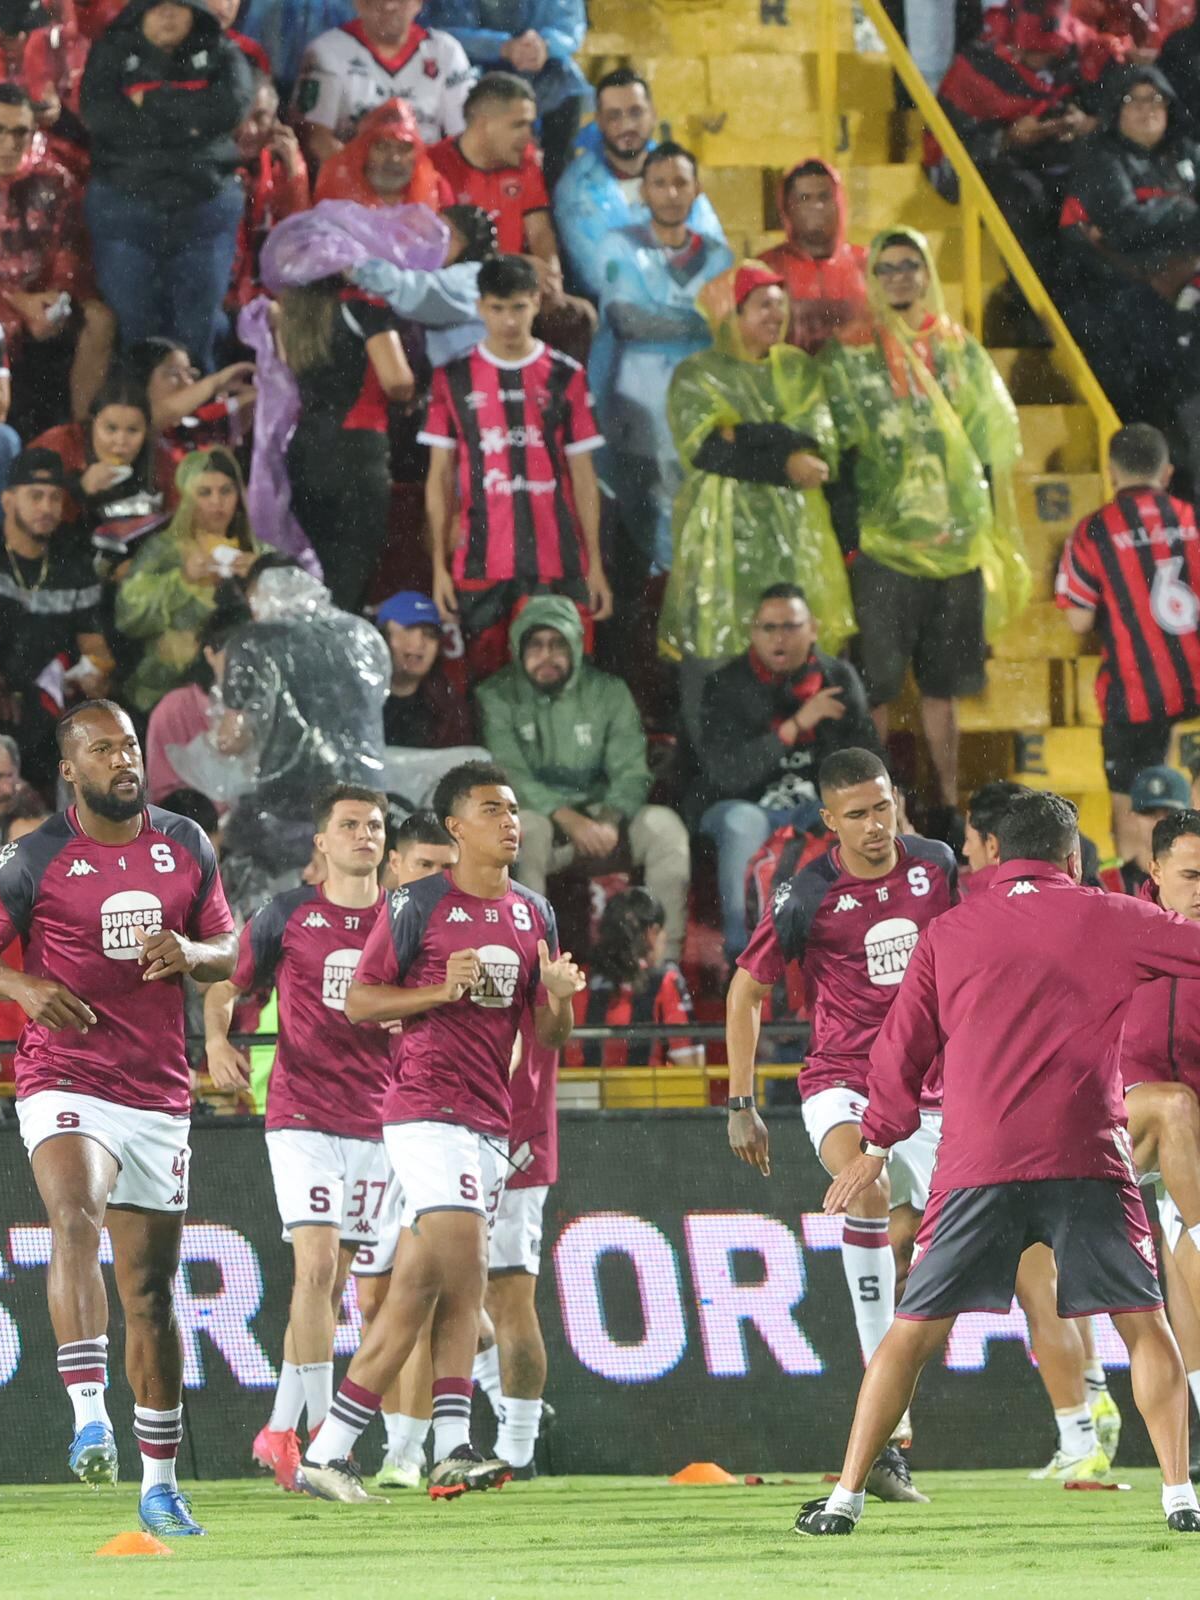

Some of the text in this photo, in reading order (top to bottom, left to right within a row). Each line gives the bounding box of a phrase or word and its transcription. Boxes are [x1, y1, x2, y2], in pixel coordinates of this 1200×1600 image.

[1150, 556, 1199, 635] 6
[118, 856, 127, 871] 4
[150, 843, 176, 873] S
[875, 886, 889, 902] 16
[907, 866, 931, 897] S
[101, 909, 163, 929] BURGER
[344, 916, 360, 930] 37
[484, 908, 499, 923] 33
[512, 902, 532, 931] S
[323, 965, 356, 980] BUR
[868, 948, 914, 977] KIN
[322, 979, 352, 998] KI
[56, 1111, 80, 1129] S
[309, 1186, 331, 1213] S
[347, 1179, 387, 1219] 37
[459, 1173, 479, 1201] S
[858, 1275, 880, 1302] S
